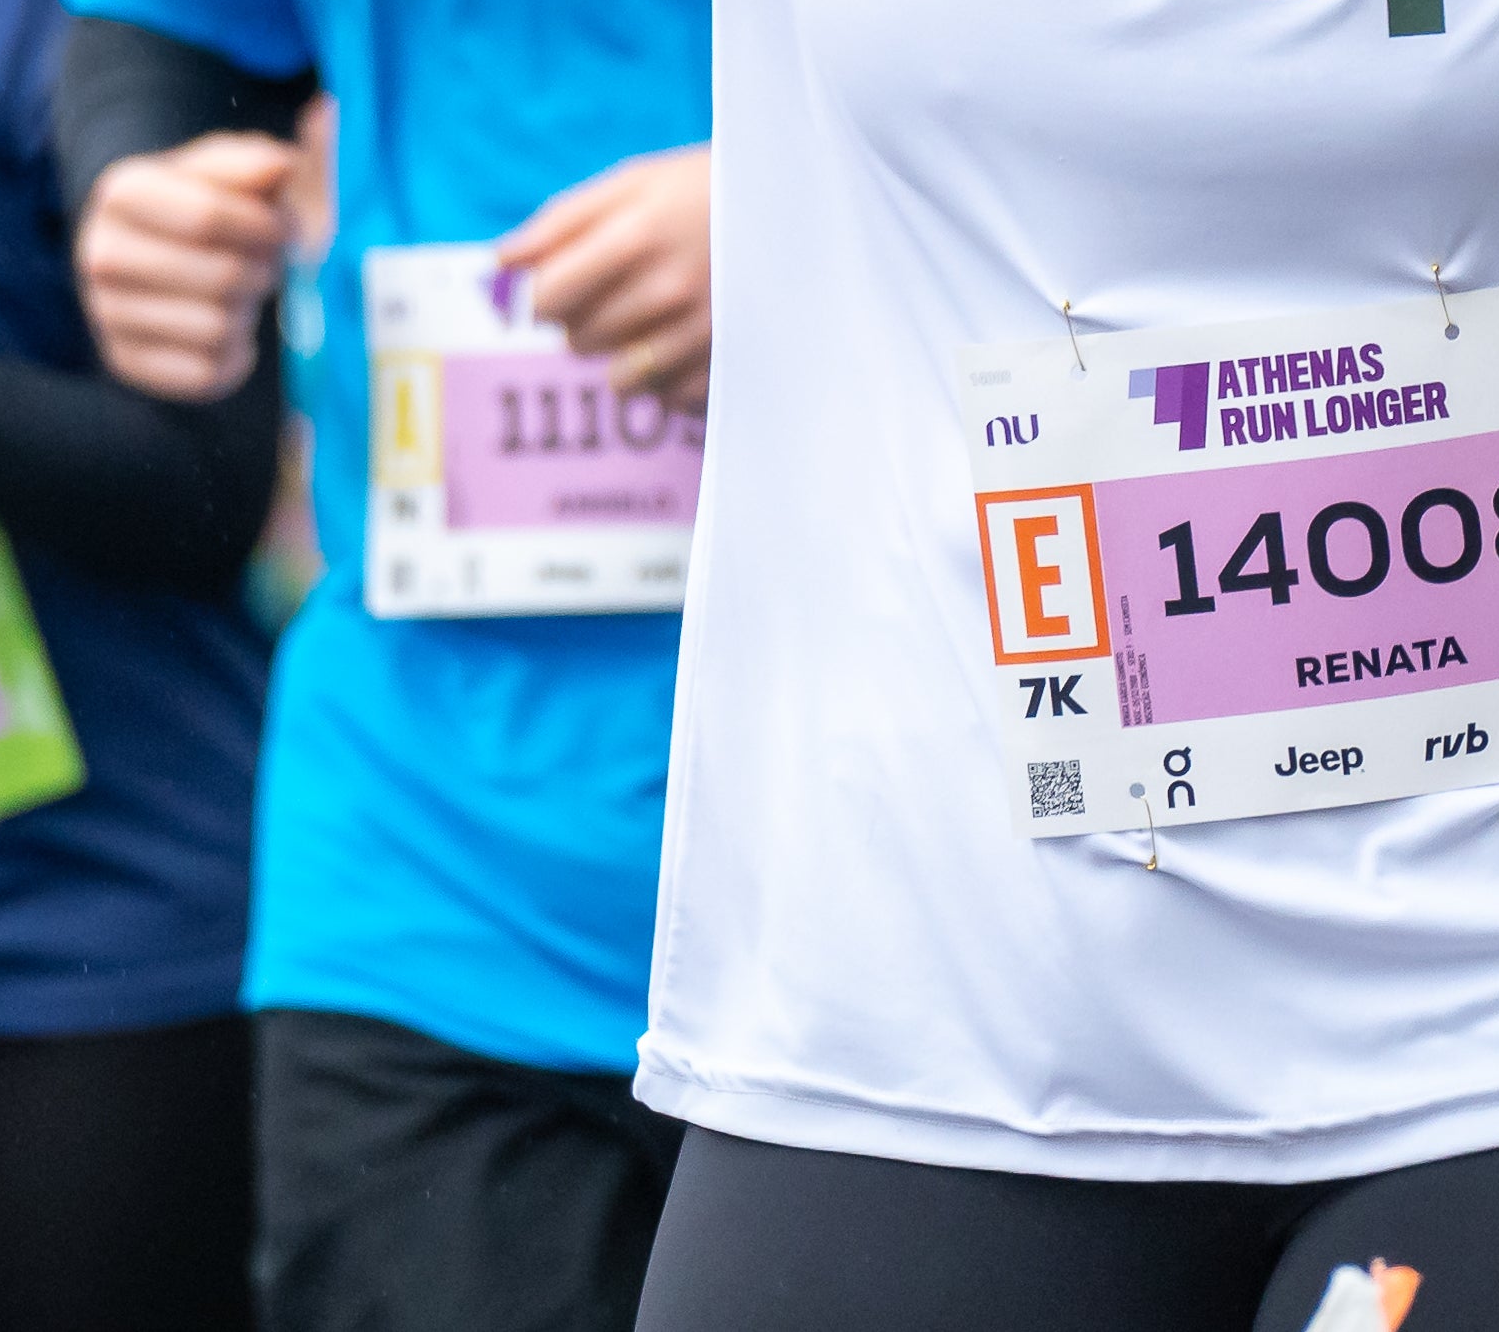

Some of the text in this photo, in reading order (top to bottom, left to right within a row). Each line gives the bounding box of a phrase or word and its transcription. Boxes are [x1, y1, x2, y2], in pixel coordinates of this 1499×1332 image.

[1217, 343, 1386, 400] ATHENAS
[499, 385, 706, 456] 1110
[1220, 381, 1450, 447] RUN LONGER
[1013, 515, 1071, 639] E
[1295, 635, 1469, 689] RENATA
[1019, 673, 1089, 720] 7K
[1274, 745, 1365, 777] Jeep
[1424, 722, 1490, 763] rvb
